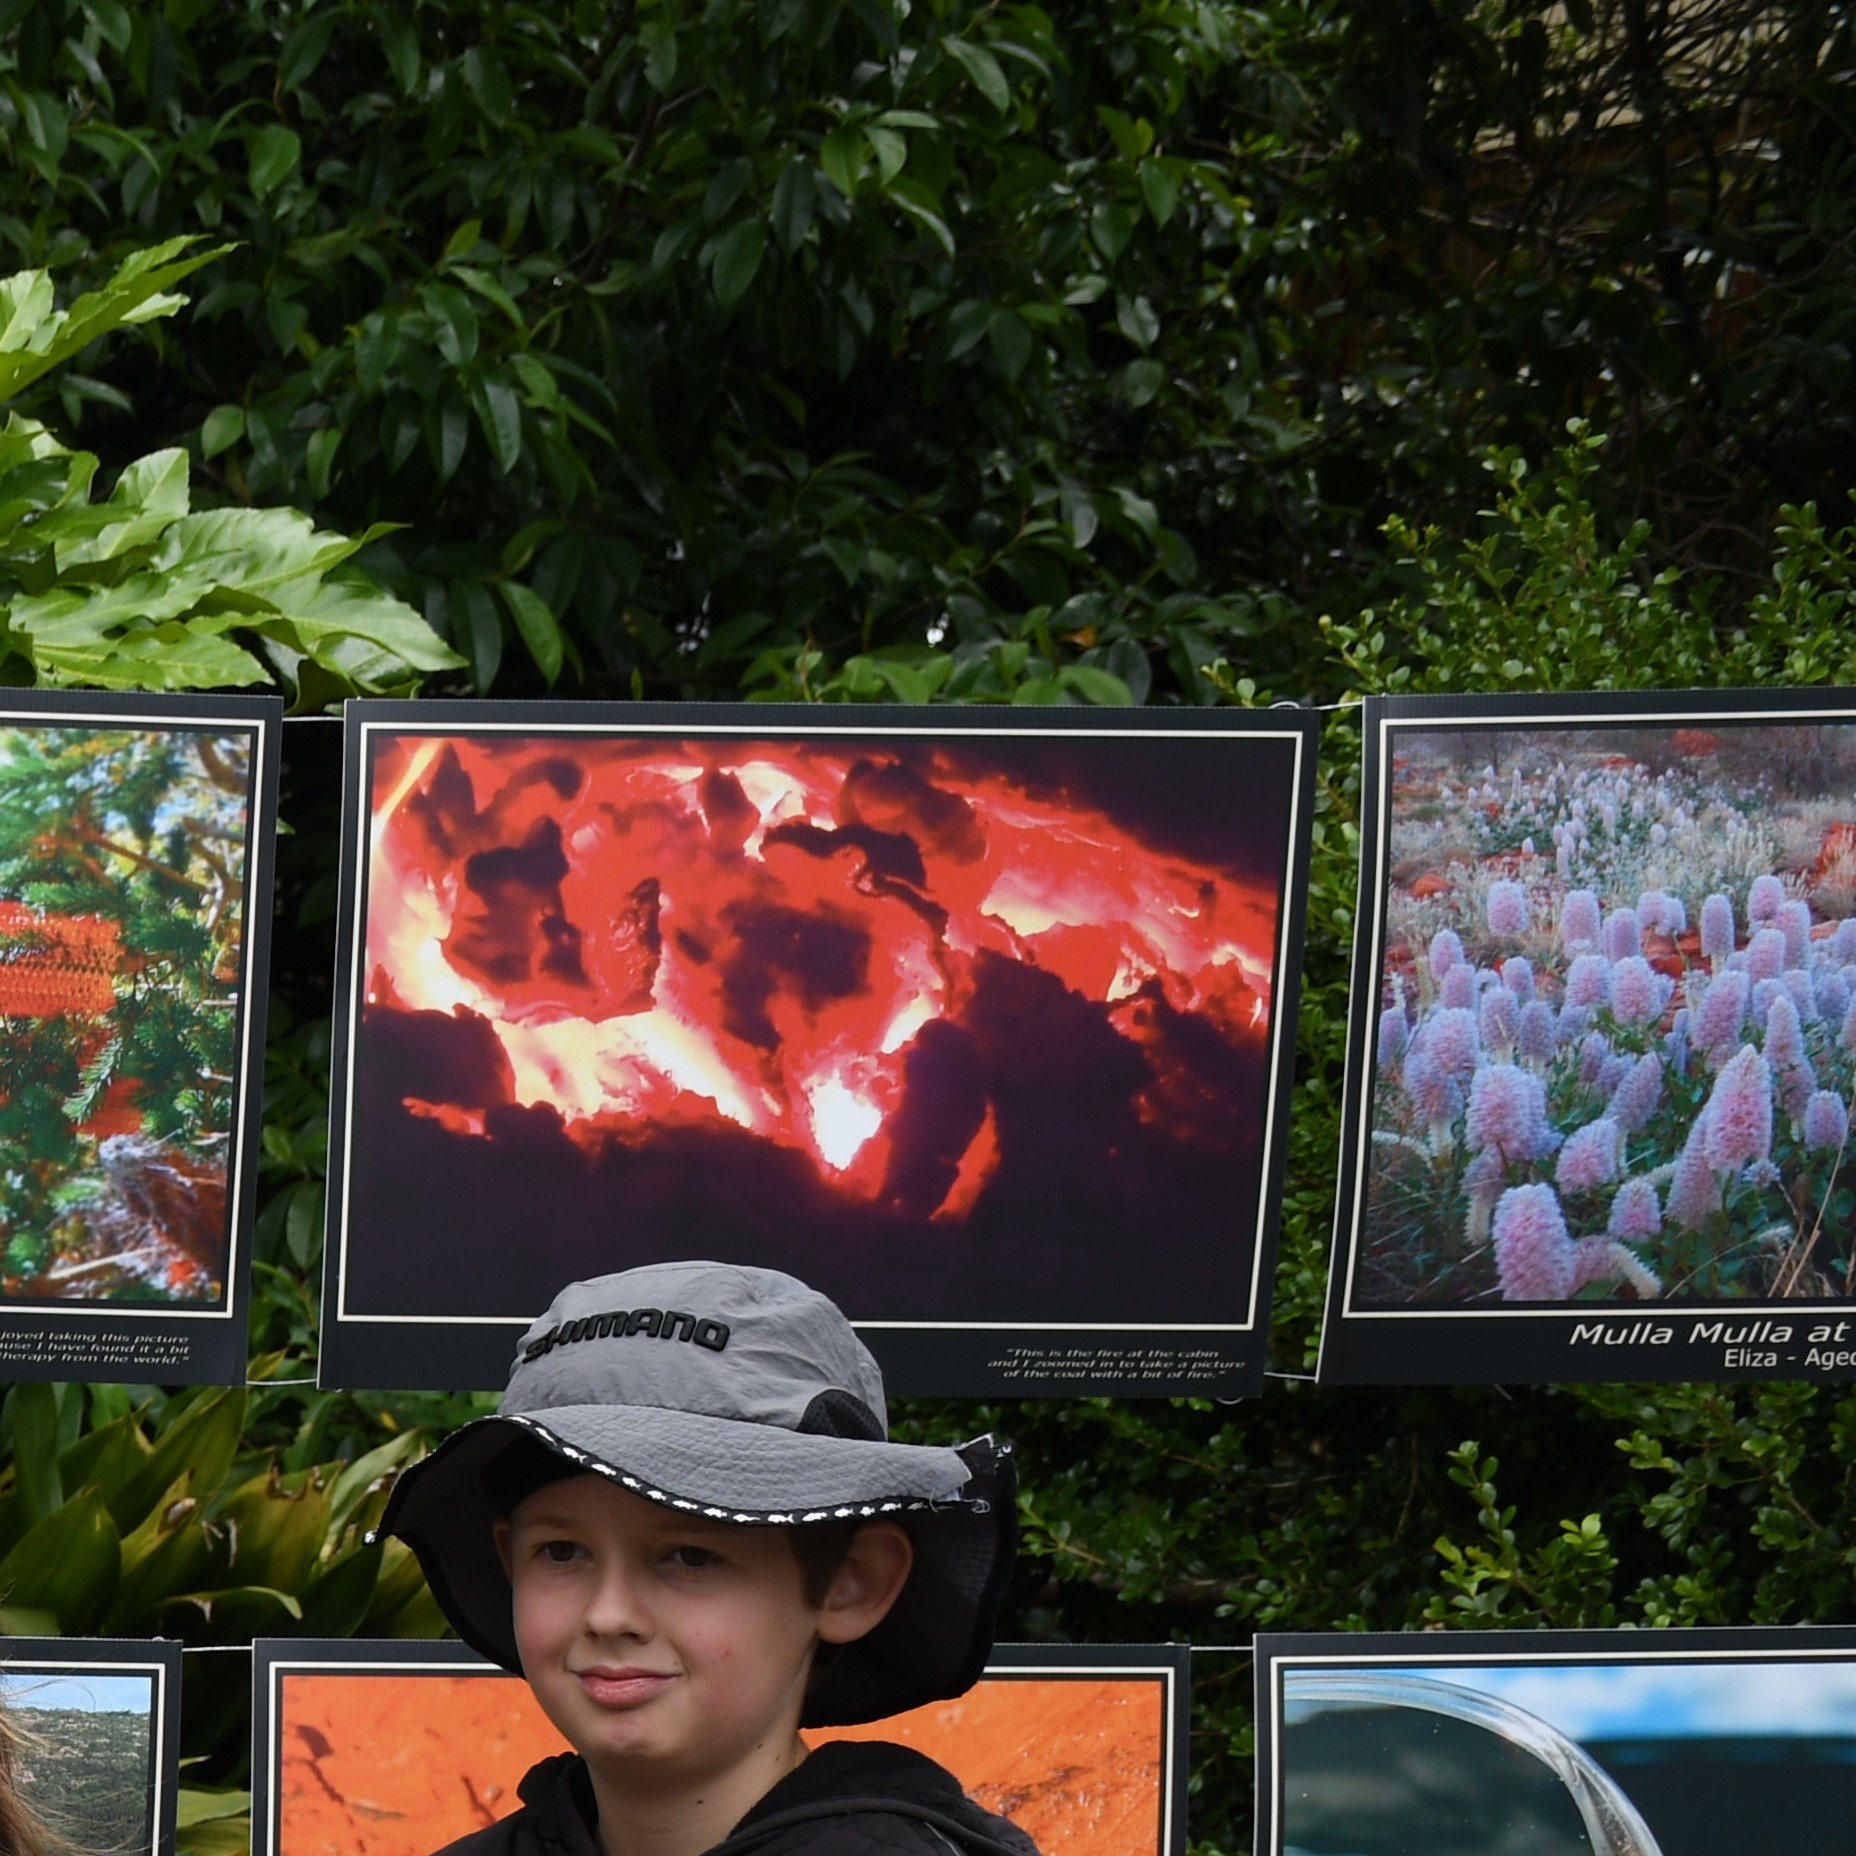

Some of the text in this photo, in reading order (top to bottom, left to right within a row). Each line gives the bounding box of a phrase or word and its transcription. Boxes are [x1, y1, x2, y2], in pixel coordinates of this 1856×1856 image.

[48, 1332, 96, 1343] taking
[101, 1333, 130, 1343] this
[134, 1334, 189, 1344] picture
[522, 1308, 730, 1364] SHIMANO
[1569, 1321, 1851, 1345] Mulla Mulla at
[48, 1341, 86, 1351] have
[89, 1343, 135, 1353] found
[139, 1344, 150, 1353] it
[169, 1345, 190, 1355] bit
[1049, 1349, 1061, 1357] is
[1067, 1349, 1092, 1357] the
[1097, 1349, 1123, 1357] fire
[1127, 1350, 1142, 1358] at
[1148, 1350, 1173, 1358] the
[1177, 1350, 1219, 1358] cabin
[61, 1352, 98, 1362] from
[103, 1353, 129, 1363] the
[1724, 1348, 1778, 1368] Eliza
[988, 1359, 1018, 1367] and
[1033, 1359, 1096, 1368] zoomed
[1099, 1360, 1114, 1368] in
[1119, 1360, 1135, 1368] to
[1139, 1360, 1173, 1368] take
[1191, 1360, 1245, 1370] picture
[1003, 1370, 1020, 1378] of
[1024, 1370, 1049, 1378] the
[1090, 1370, 1123, 1378] with
[1142, 1370, 1162, 1379] bit
[1167, 1370, 1184, 1379] of
